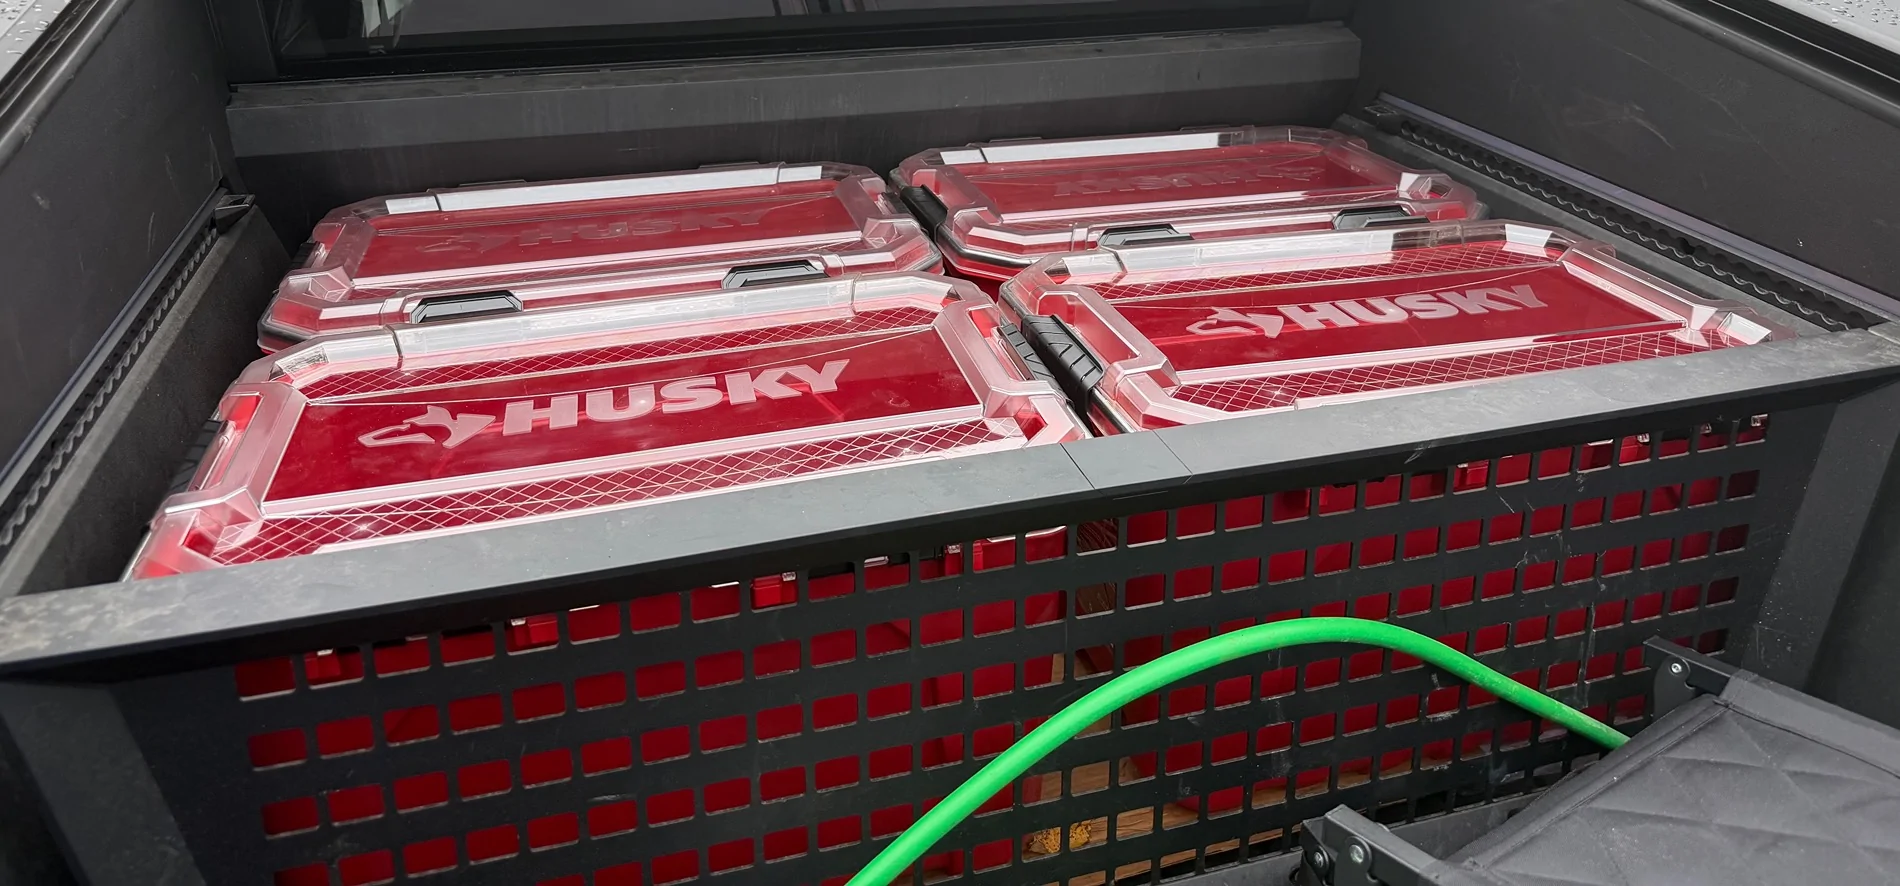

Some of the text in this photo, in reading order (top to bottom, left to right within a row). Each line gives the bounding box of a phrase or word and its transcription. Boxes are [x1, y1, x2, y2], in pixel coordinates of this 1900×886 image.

[519, 208, 772, 247] HUSKY
[1277, 284, 1548, 331] HUSKY
[502, 359, 851, 437] HUSKY
